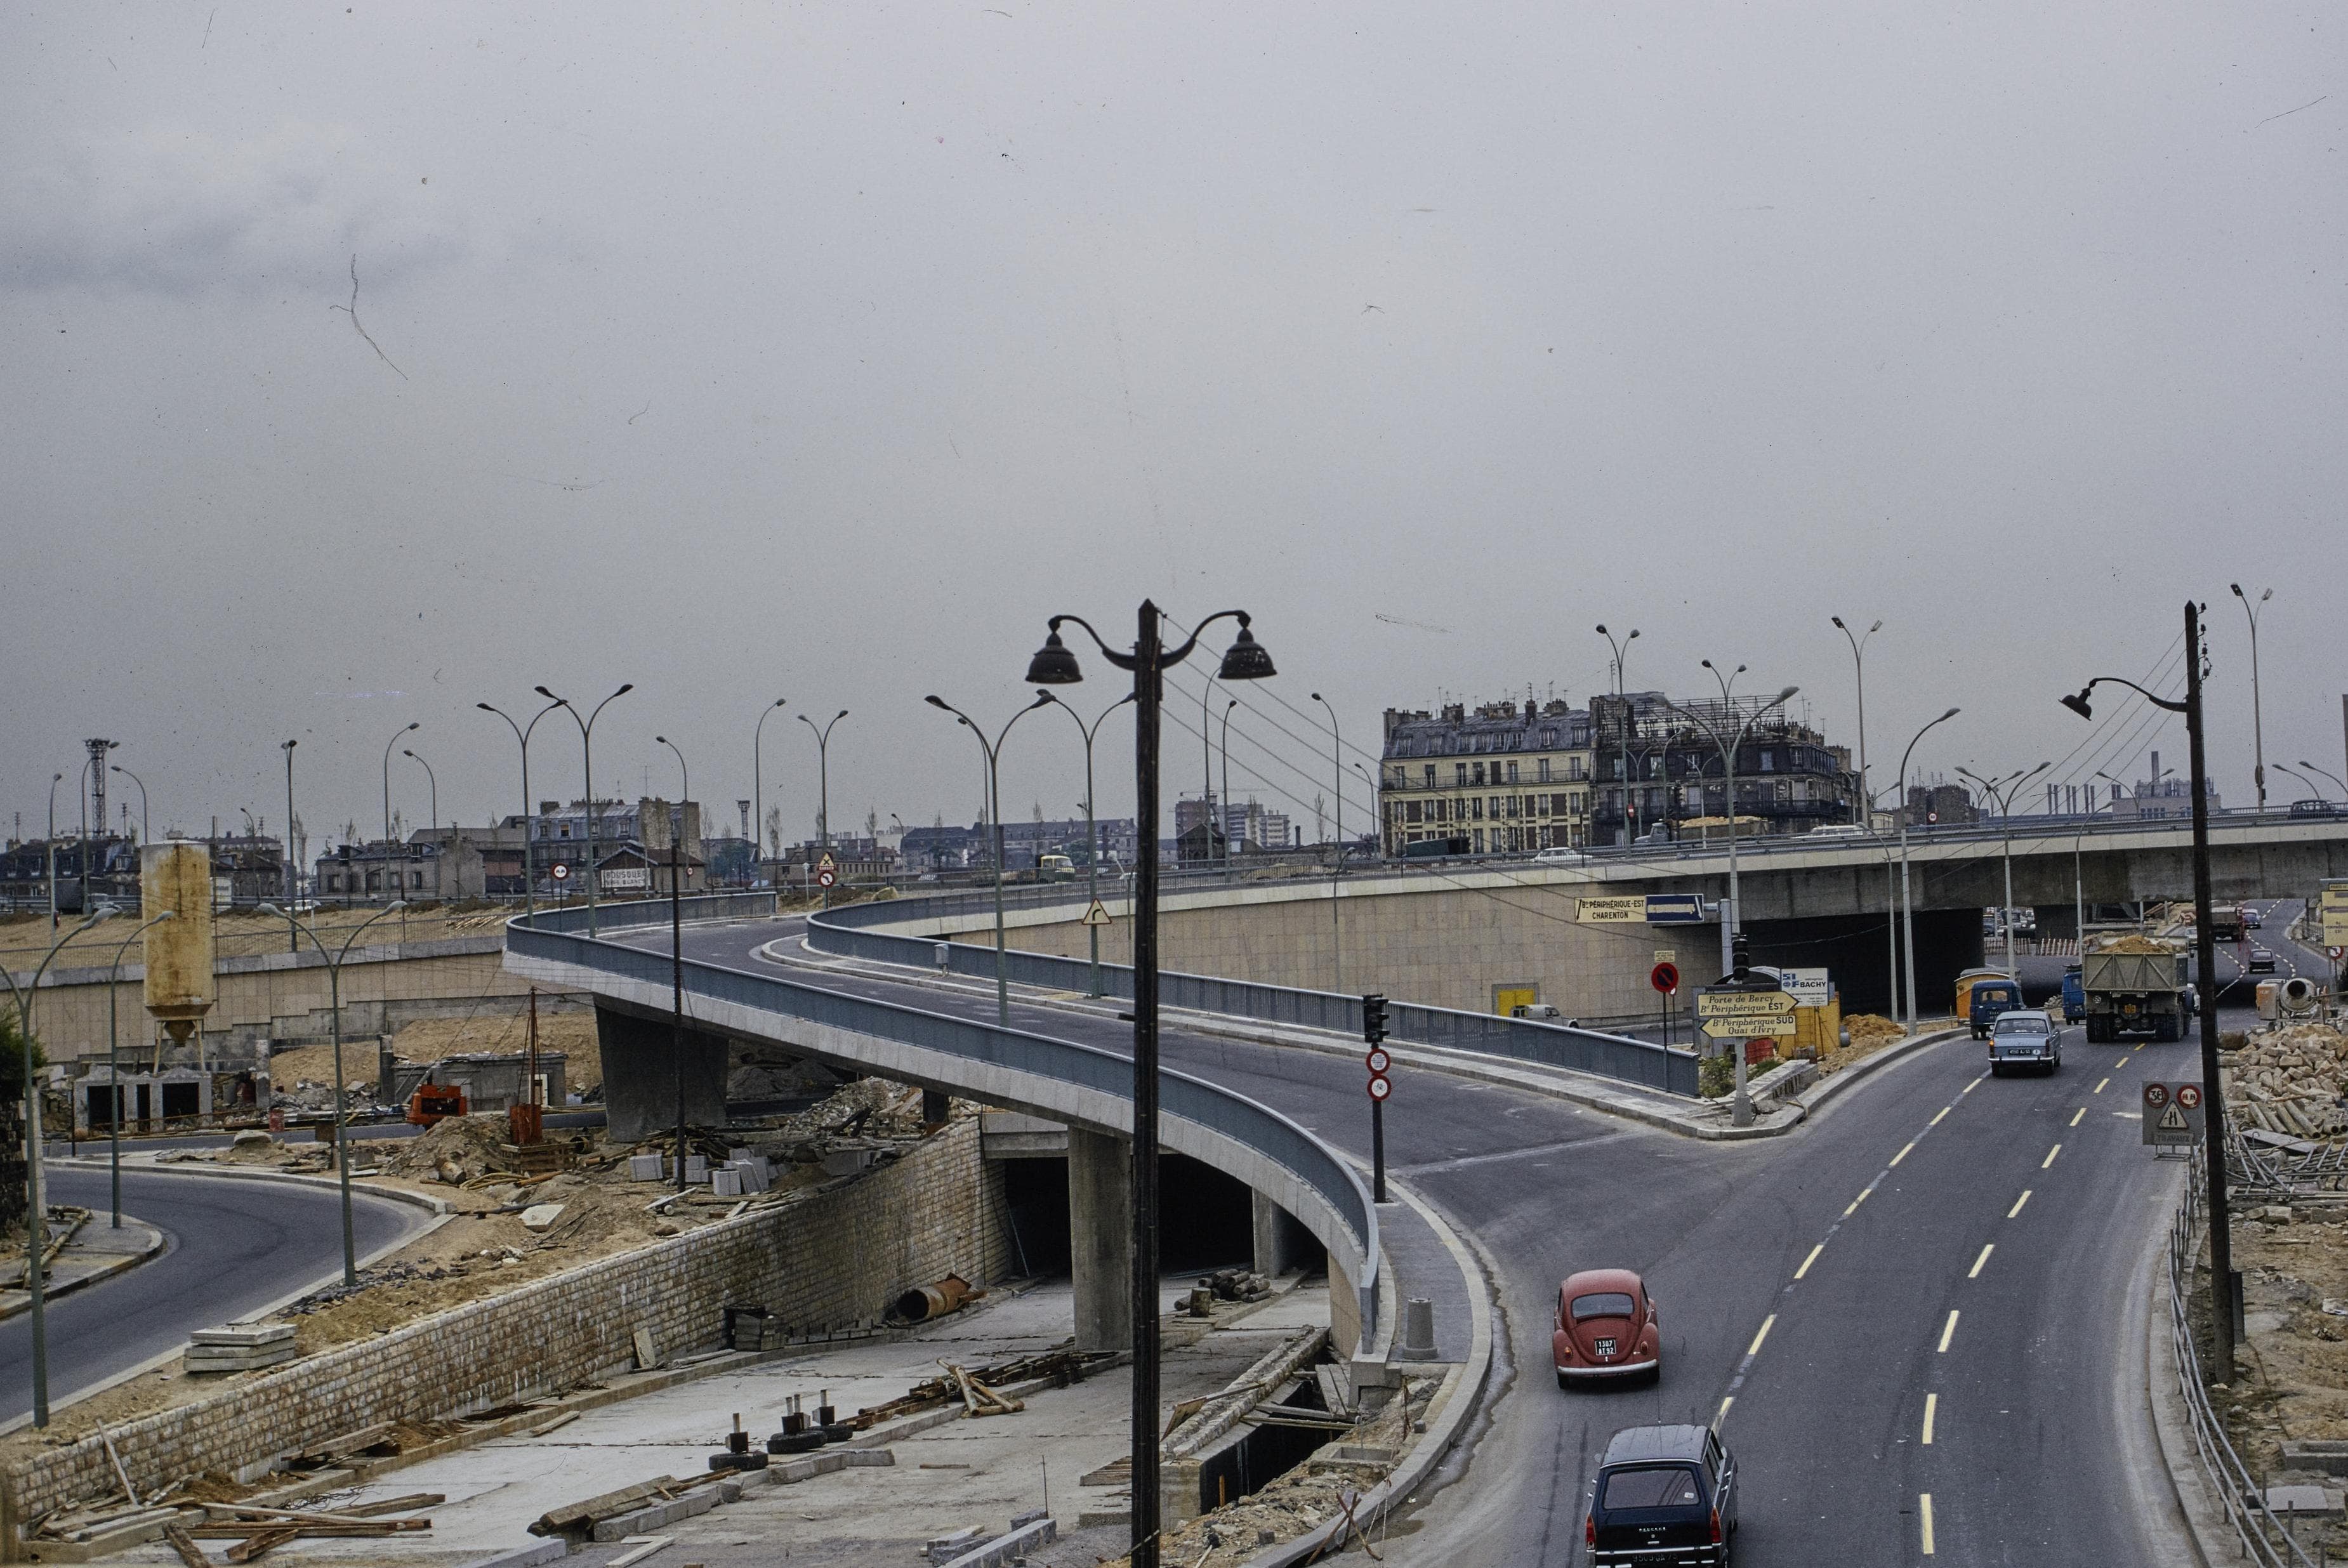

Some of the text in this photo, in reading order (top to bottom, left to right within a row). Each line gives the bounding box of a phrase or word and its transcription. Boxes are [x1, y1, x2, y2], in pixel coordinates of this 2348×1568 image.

[1592, 911, 1628, 919] CHARENTON
[1709, 996, 1734, 1004] Porte
[1748, 994, 1775, 1003] Bercy
[1711, 1003, 1766, 1014] Périphérique
[1768, 1002, 1784, 1011] EST
[1722, 1017, 1776, 1028] Périphérique
[1728, 1027, 1777, 1035] Quai d'Ivry
[2150, 1090, 2164, 1101] 30
